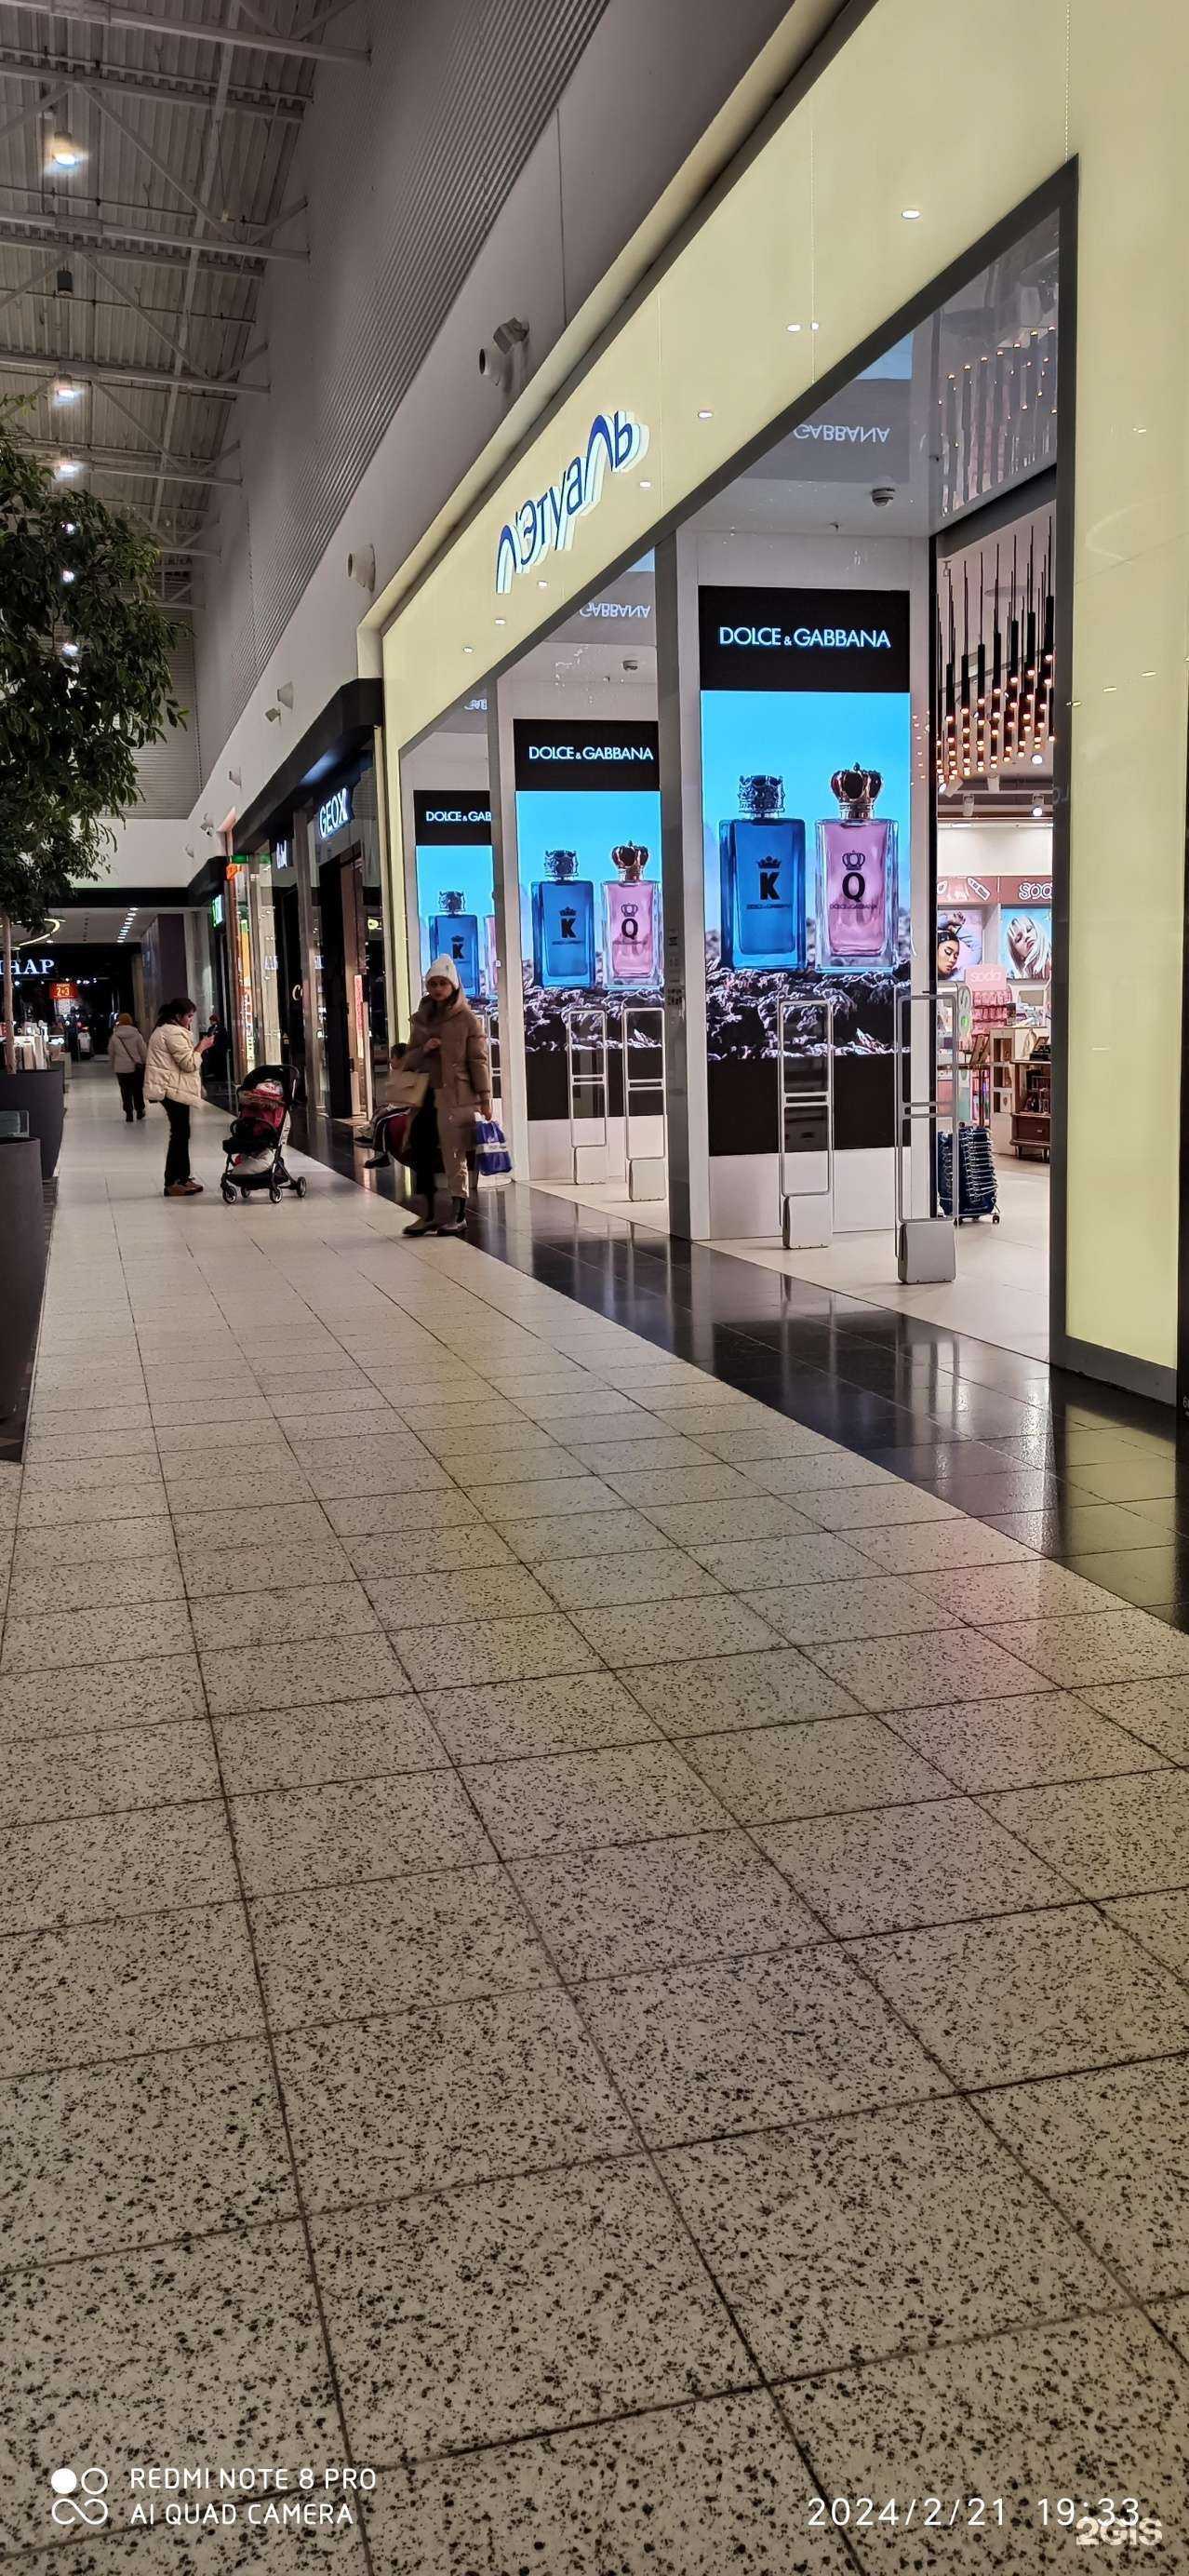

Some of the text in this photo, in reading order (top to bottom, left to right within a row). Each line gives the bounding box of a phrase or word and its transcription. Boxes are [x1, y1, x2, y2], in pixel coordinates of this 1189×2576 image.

[719, 626, 891, 649] DOLCE & GABBANA
[528, 746, 574, 760] DOLCE
[582, 746, 654, 760] GABBANA
[319, 787, 349, 839] GEOX
[425, 811, 461, 822] DOLCE
[759, 871, 781, 901] K
[842, 871, 866, 903] Q
[561, 918, 577, 938] K
[621, 918, 639, 940] Q
[452, 943, 465, 959] K
